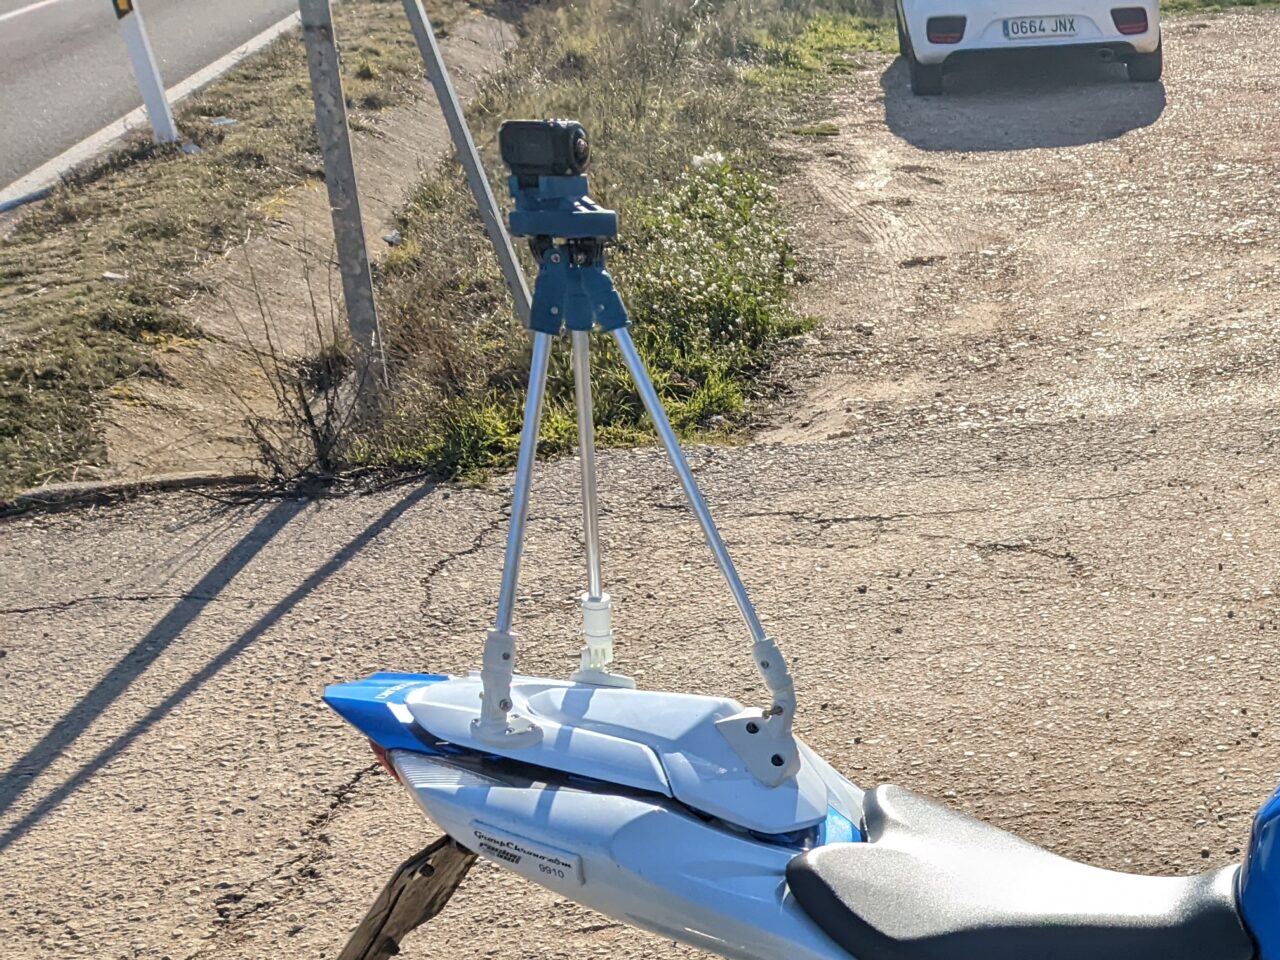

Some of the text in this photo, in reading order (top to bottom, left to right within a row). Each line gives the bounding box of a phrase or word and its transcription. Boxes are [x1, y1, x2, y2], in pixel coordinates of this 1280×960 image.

[1011, 18, 1076, 35] 0664 JNX
[539, 863, 565, 879] 9910
